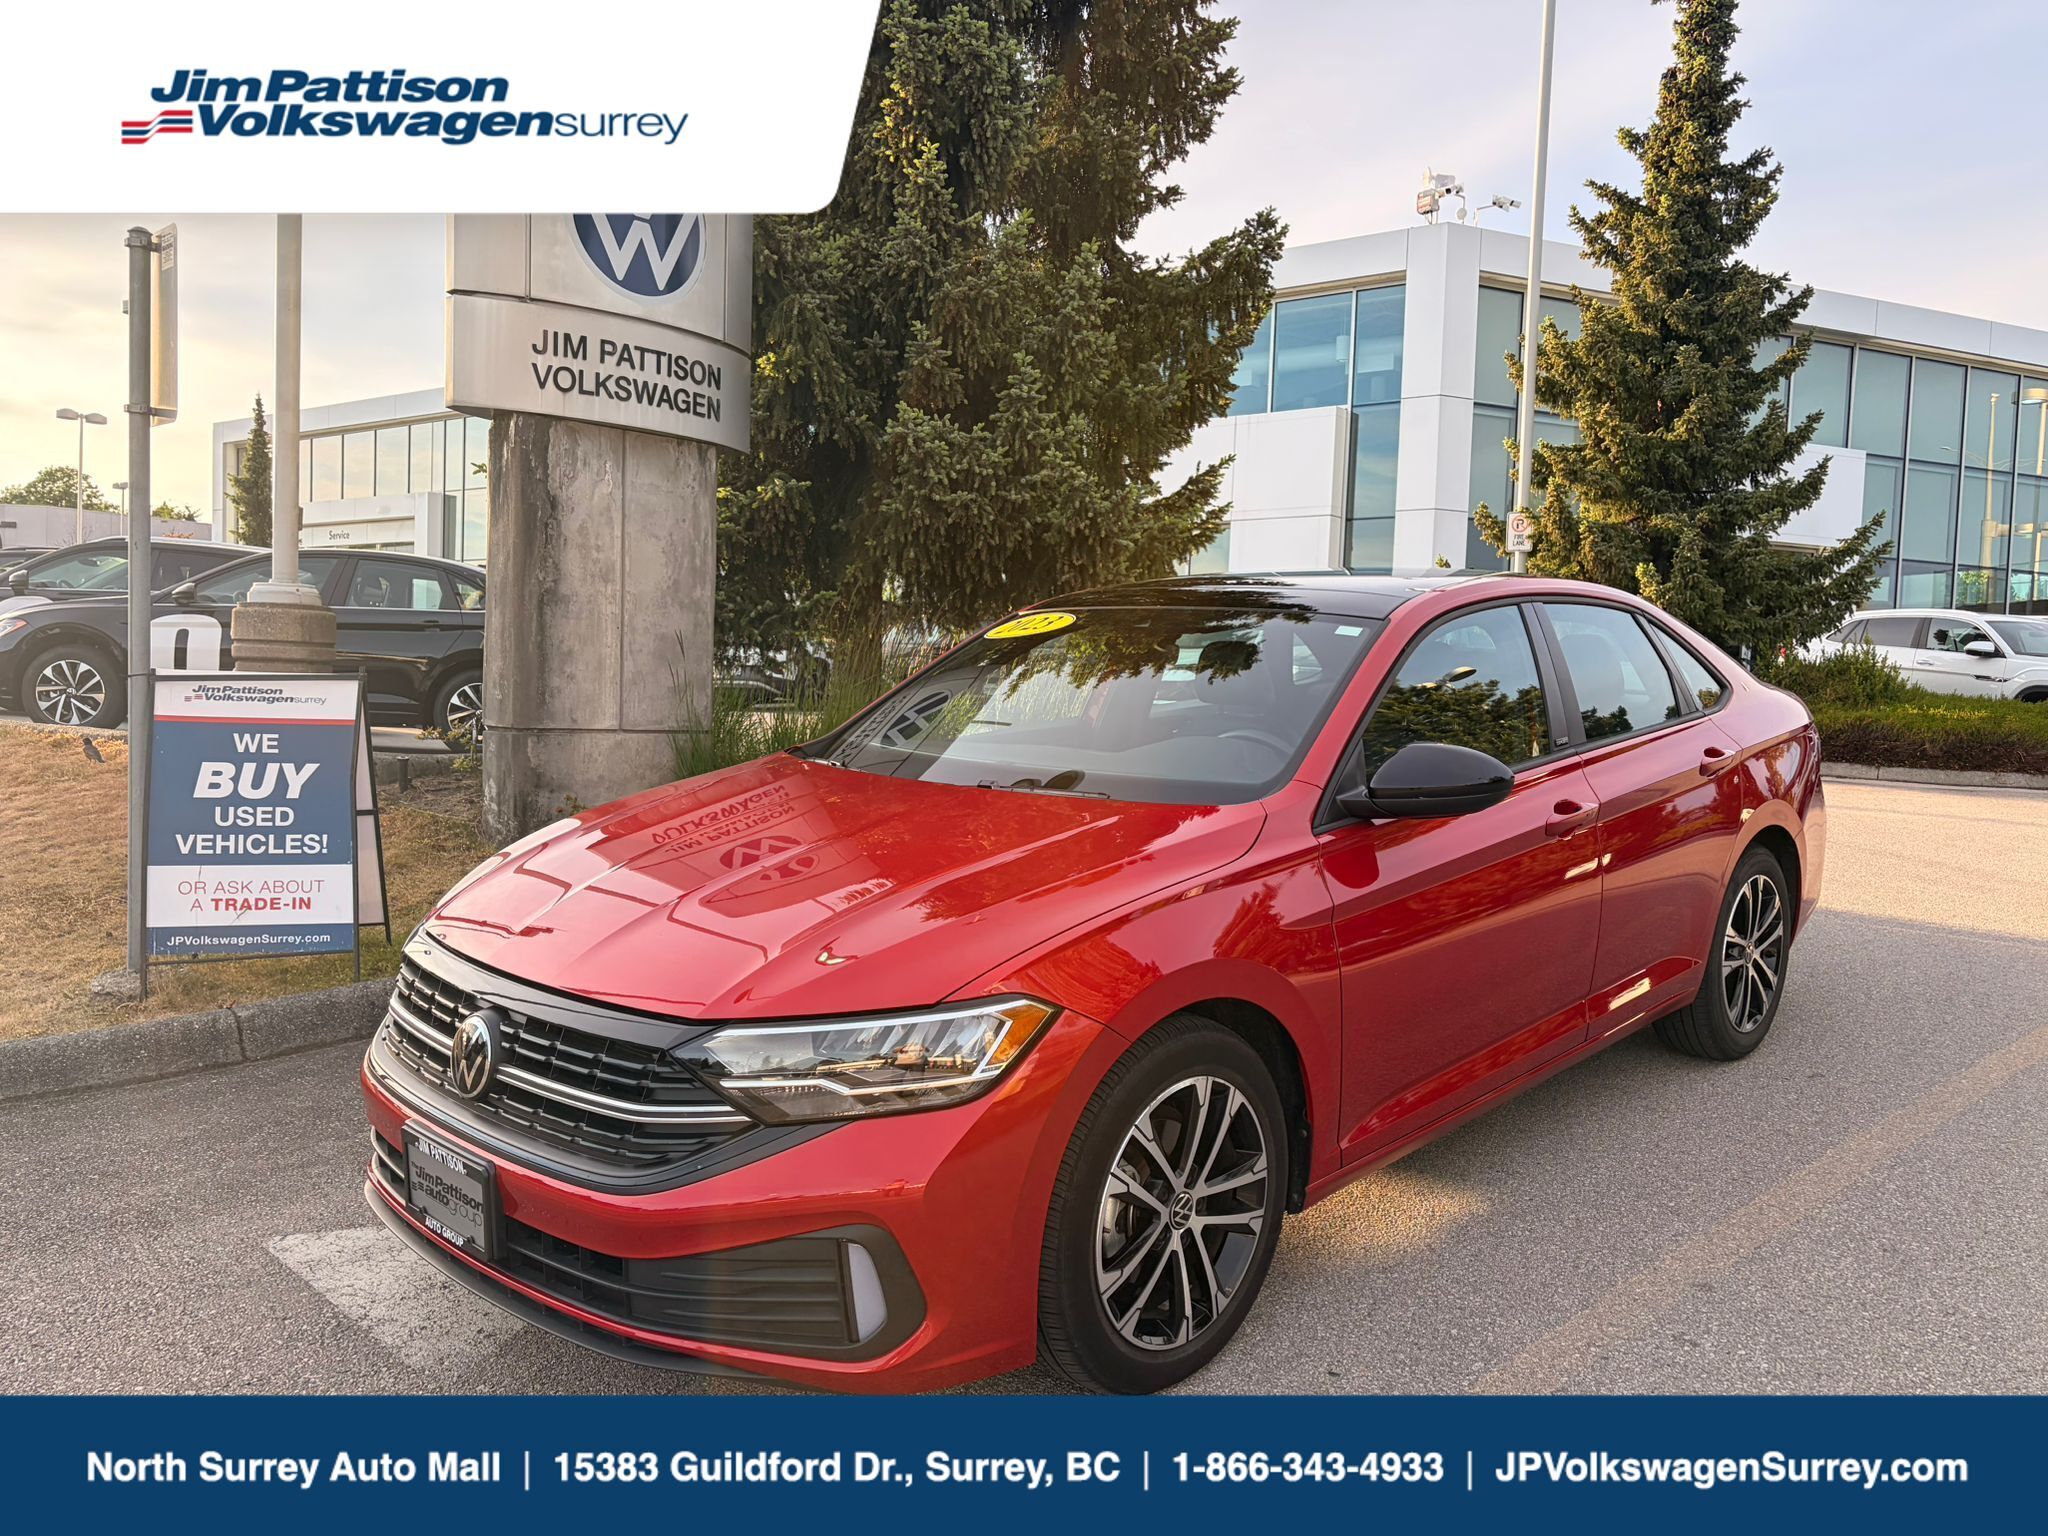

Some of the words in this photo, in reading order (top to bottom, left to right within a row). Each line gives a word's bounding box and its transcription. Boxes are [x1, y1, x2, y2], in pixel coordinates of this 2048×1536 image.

[532, 329, 588, 361] JIM
[600, 338, 722, 391] PATTISON
[531, 362, 721, 423] VOLKSWAGEN
[328, 529, 350, 541] Service
[233, 732, 280, 754] WE
[193, 761, 320, 799] BUY
[214, 806, 295, 827] USED
[175, 833, 329, 855] VEHICLES!
[178, 881, 207, 895] OR
[213, 880, 253, 895] ASK
[259, 879, 325, 894] ABOUT
[190, 898, 204, 912] A
[210, 897, 312, 912] TRADE-IN
[167, 934, 331, 946] JPVolkswagenSurrey.com
[419, 1138, 430, 1155] JIM
[430, 1145, 464, 1175] PATTISON
[425, 1216, 440, 1234] AUTO
[442, 1225, 464, 1247] GROUP
